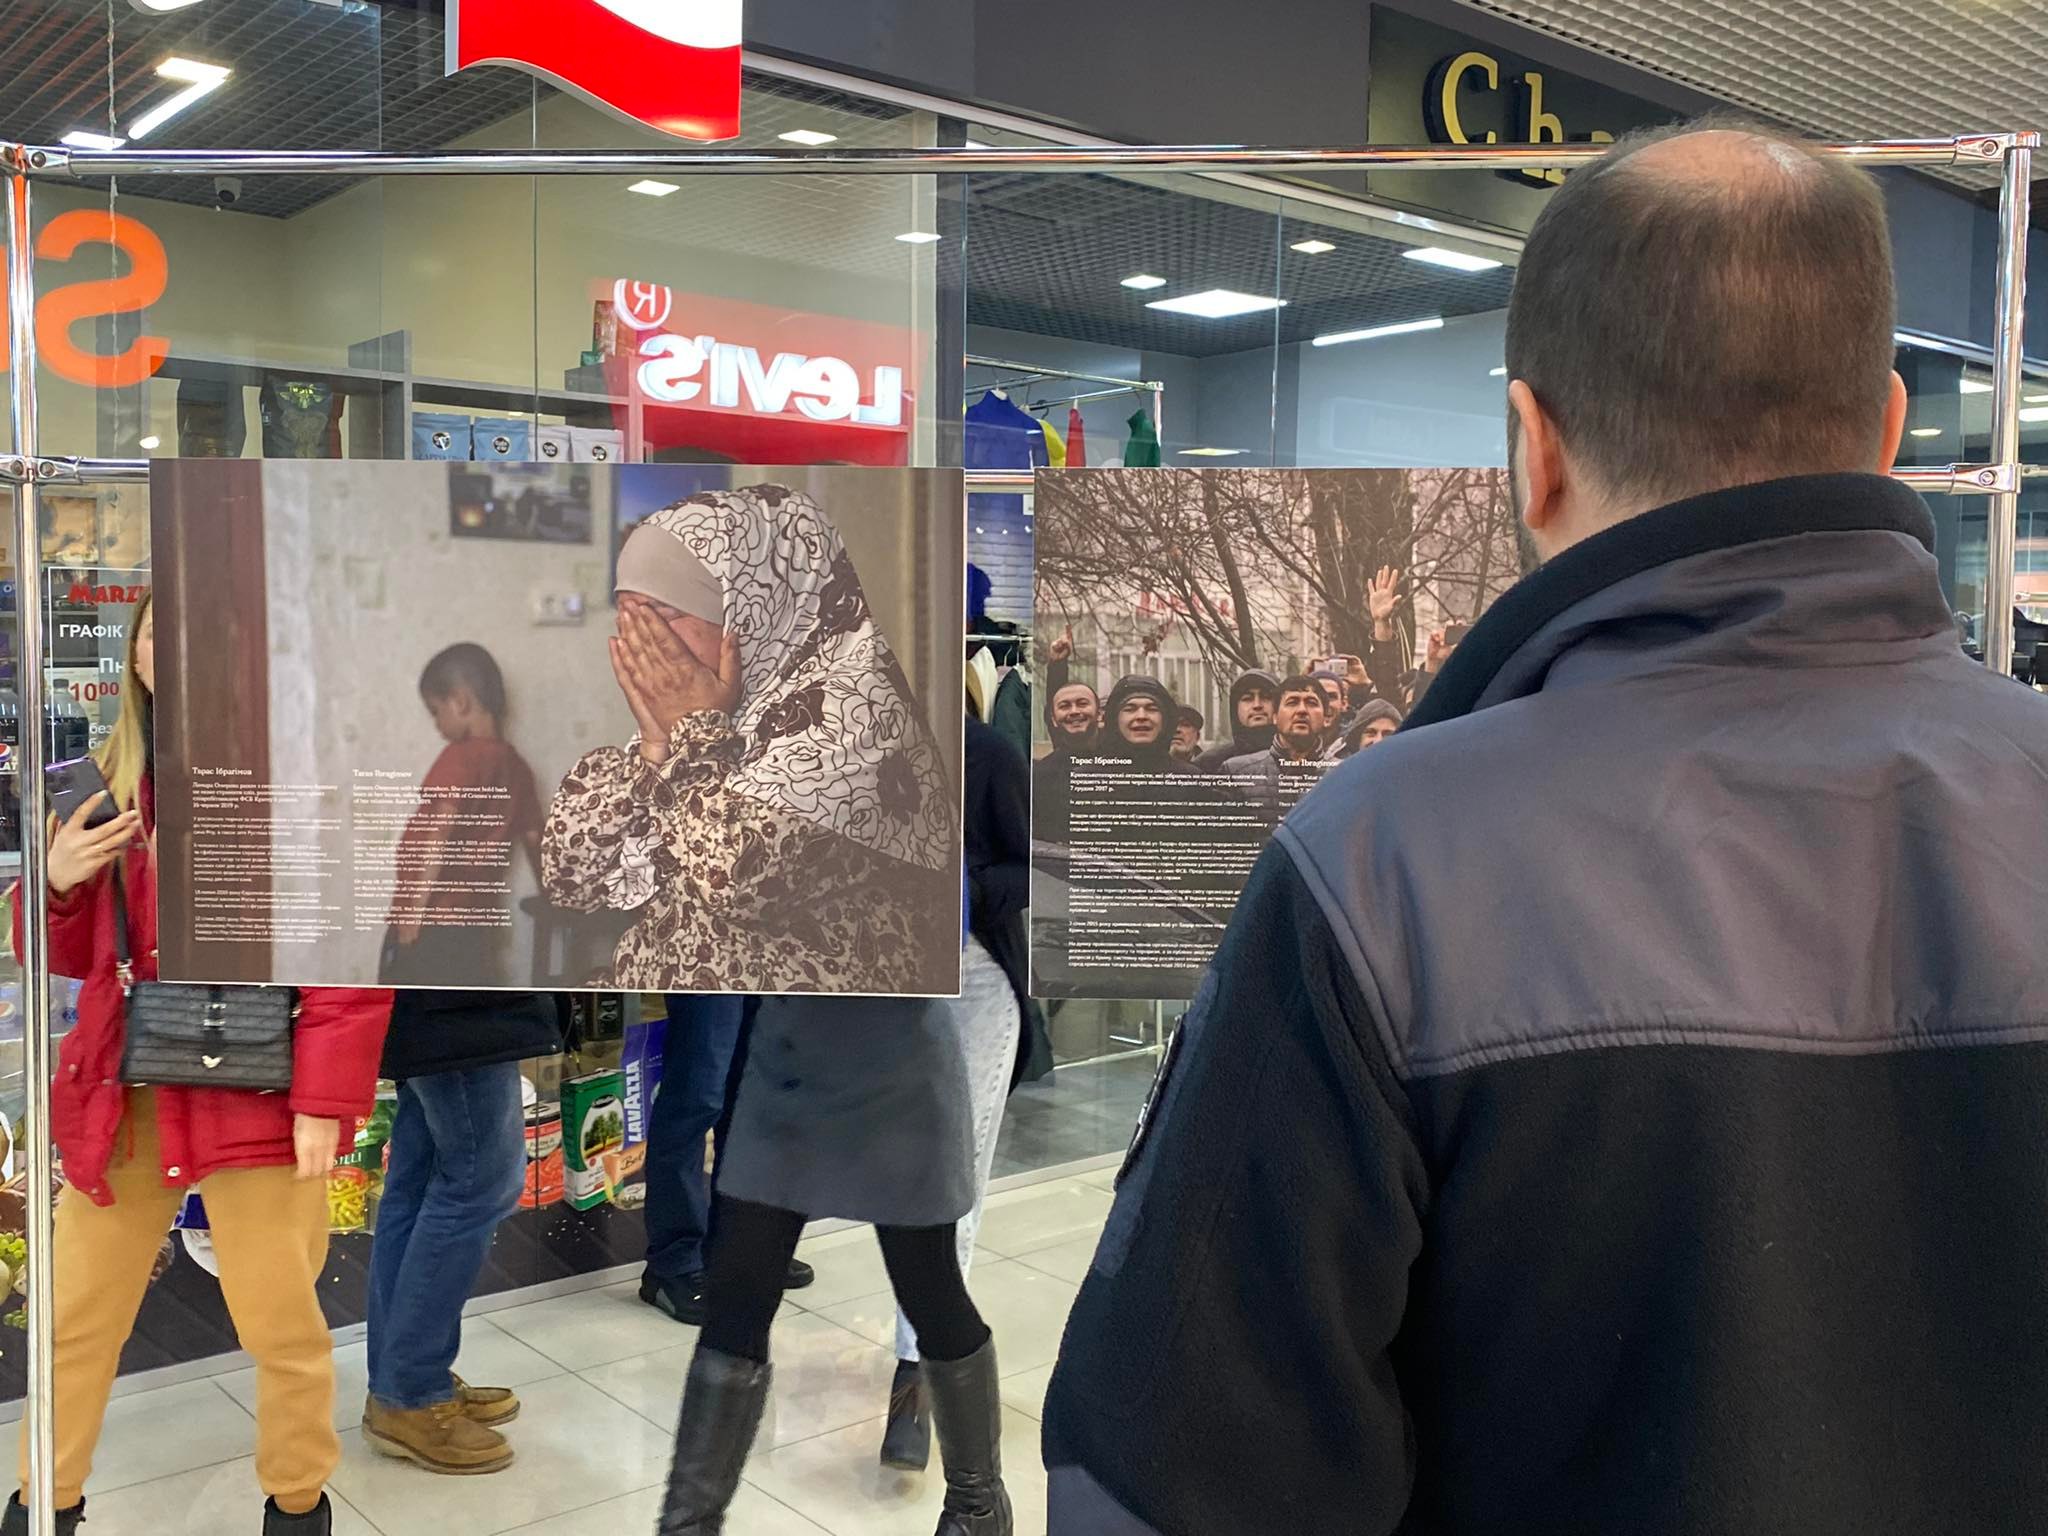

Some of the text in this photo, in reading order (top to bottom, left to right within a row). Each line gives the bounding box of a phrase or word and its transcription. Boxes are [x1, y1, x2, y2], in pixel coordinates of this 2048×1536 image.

[1442, 52, 1615, 184] Ch
[68, 584, 145, 604] MARZ
[59, 624, 122, 638] ГРАФІК
[1069, 756, 1133, 766] Тарас Ібрагімов
[1278, 758, 1339, 768] Taras Ibragimo
[623, 1059, 644, 1143] LAVAZZA
